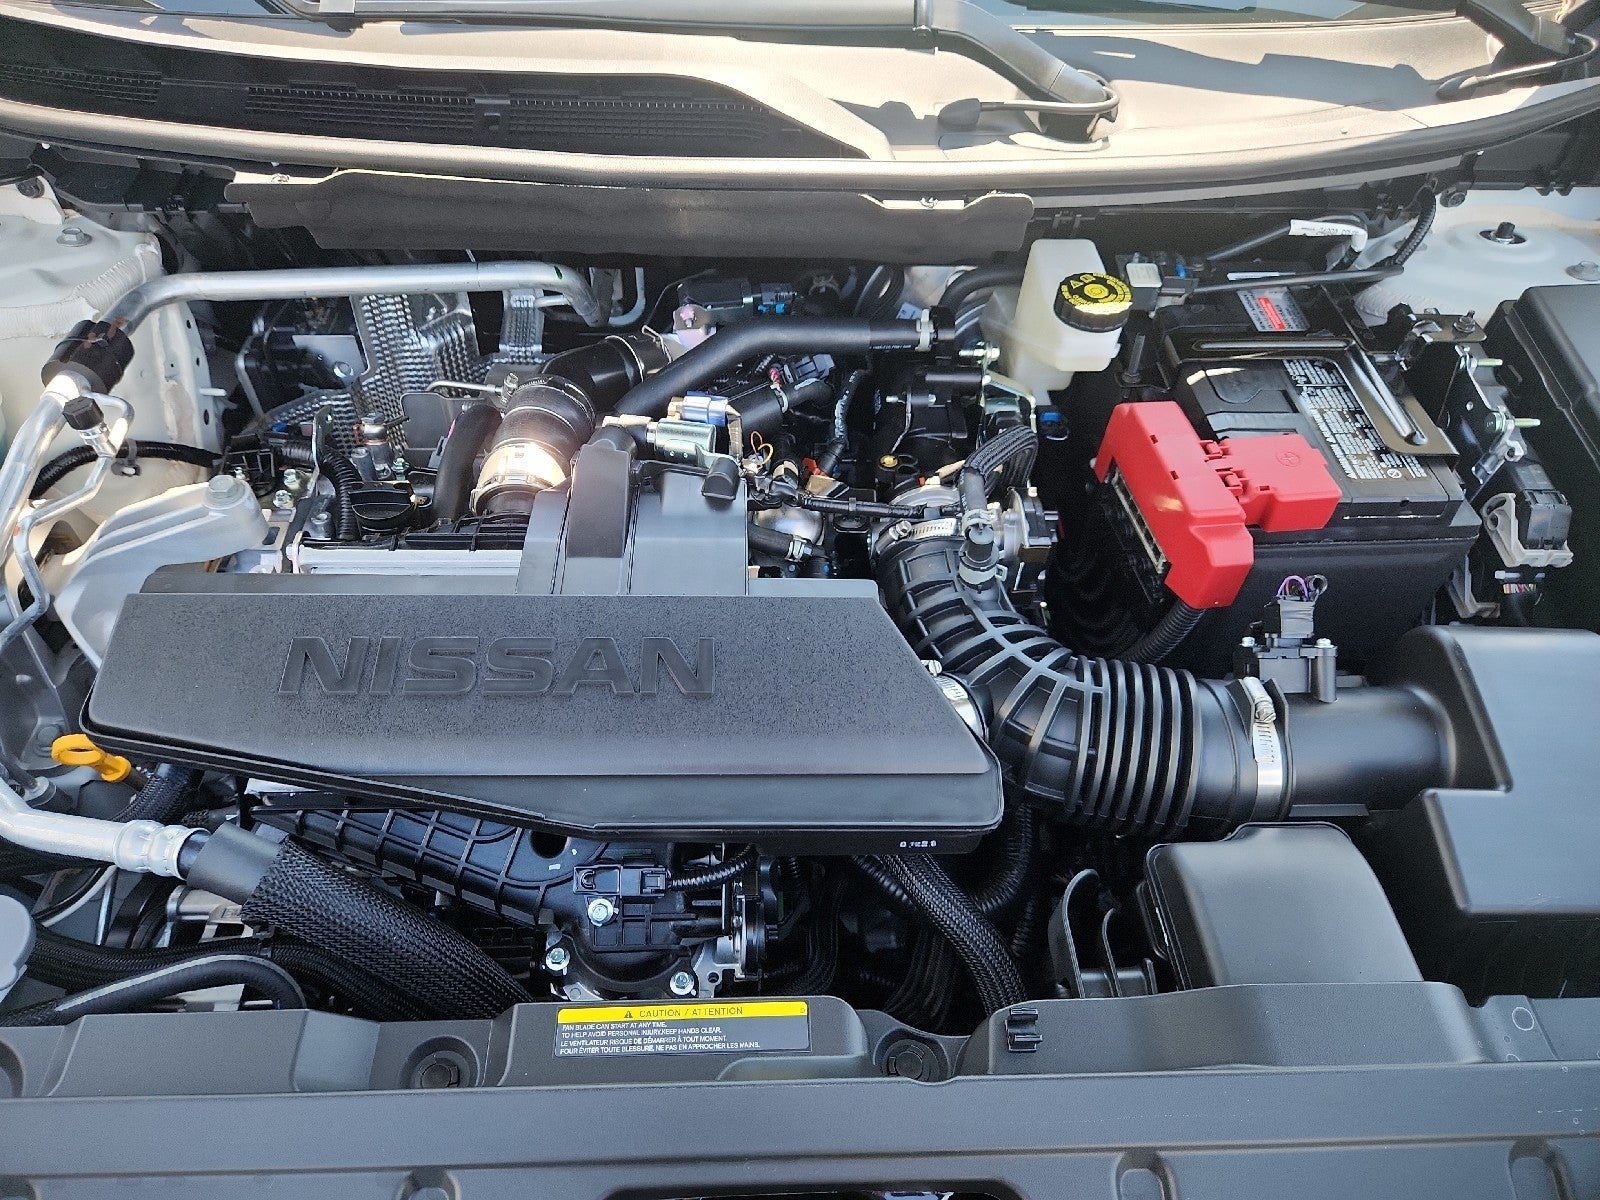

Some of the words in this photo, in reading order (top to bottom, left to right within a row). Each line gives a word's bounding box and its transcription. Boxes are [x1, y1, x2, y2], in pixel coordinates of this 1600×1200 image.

[278, 636, 715, 694] NISSAN
[640, 1009, 681, 1018] CAUTION
[692, 1007, 743, 1016] ATTENTION
[587, 1030, 606, 1038] AVOID
[607, 1029, 640, 1037] PERSONAL
[569, 1039, 608, 1047] VENTILATEUR
[643, 1035, 676, 1044] DÉMARRER
[682, 1035, 699, 1043] TOUT
[560, 1047, 578, 1055] POUR
[579, 1045, 600, 1054] ÉVITER
[688, 1042, 726, 1050] APPROCHER
